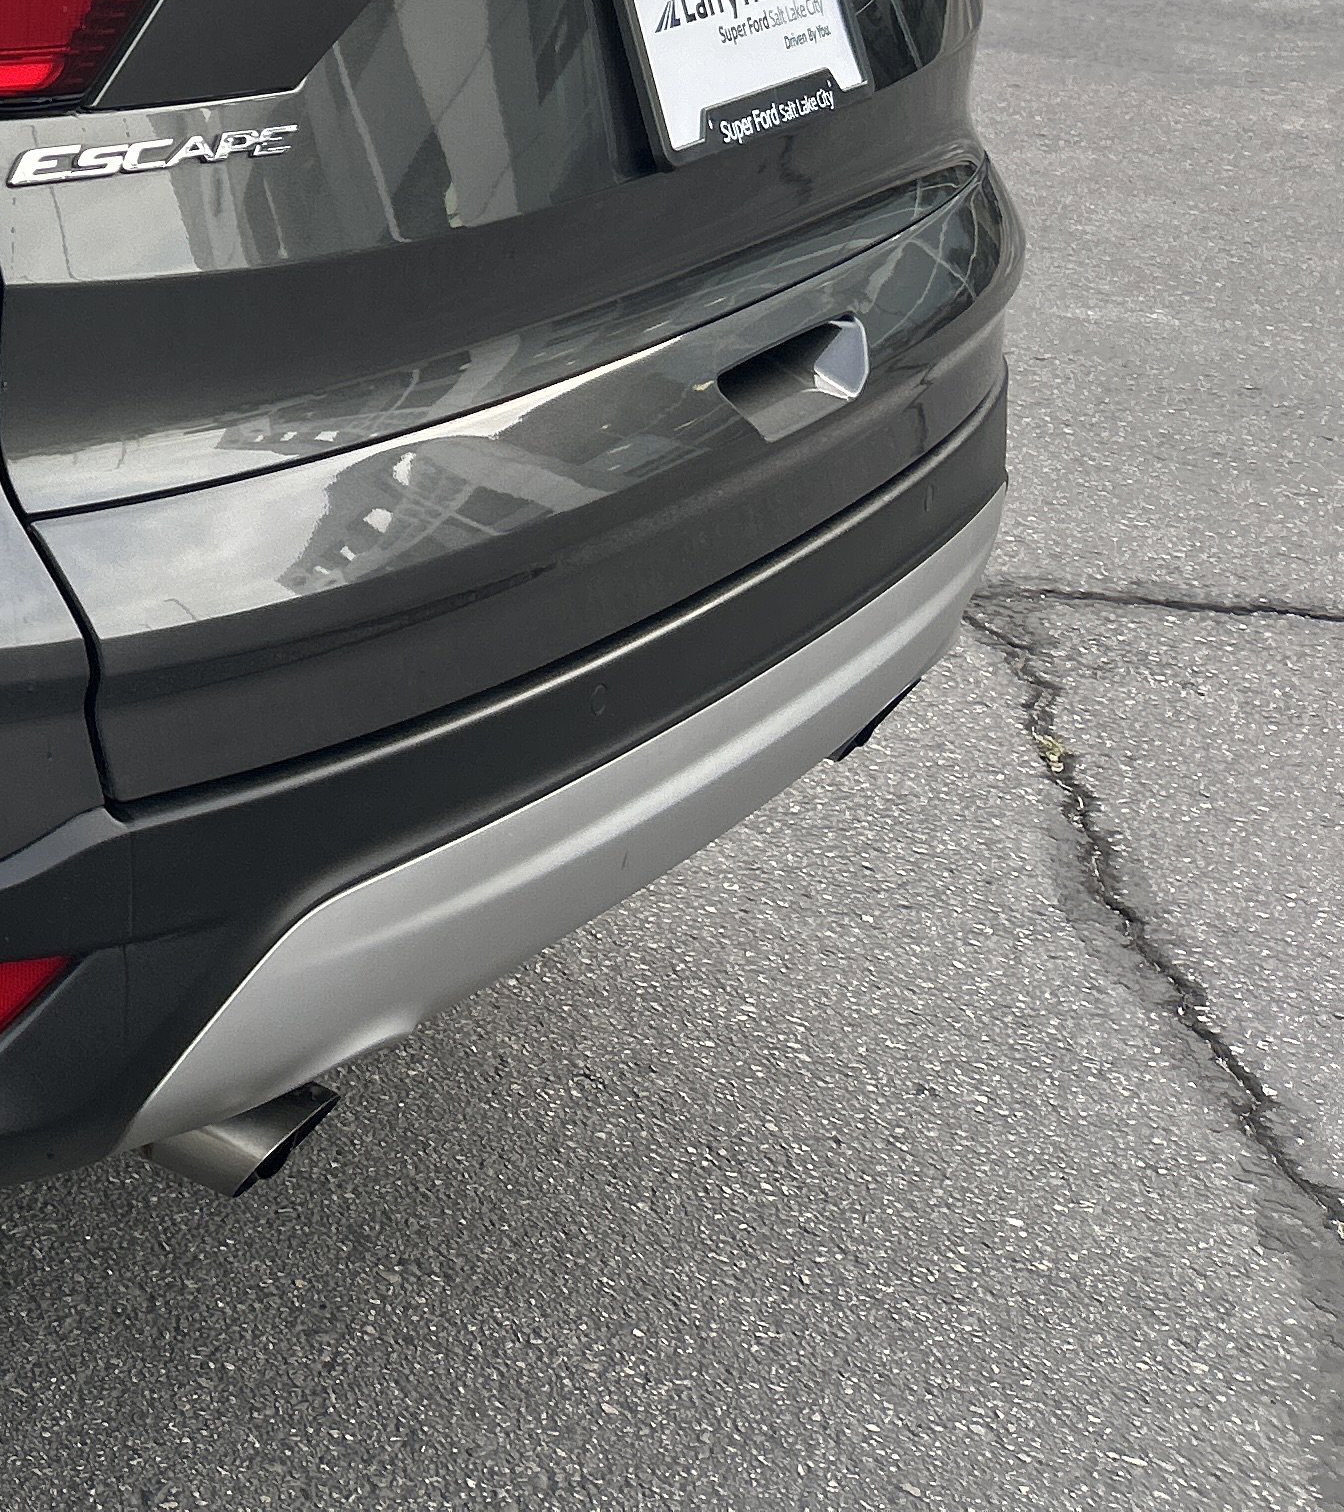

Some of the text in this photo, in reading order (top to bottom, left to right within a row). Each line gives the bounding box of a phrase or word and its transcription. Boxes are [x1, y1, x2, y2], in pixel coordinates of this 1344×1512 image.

[717, 22, 747, 46] Super
[746, 9, 771, 36] Ford
[768, 4, 786, 28] Salt
[783, 23, 833, 50] Driven By You
[719, 87, 835, 145] Super Ford Salt Lake City
[6, 123, 300, 188] ESCAPE
